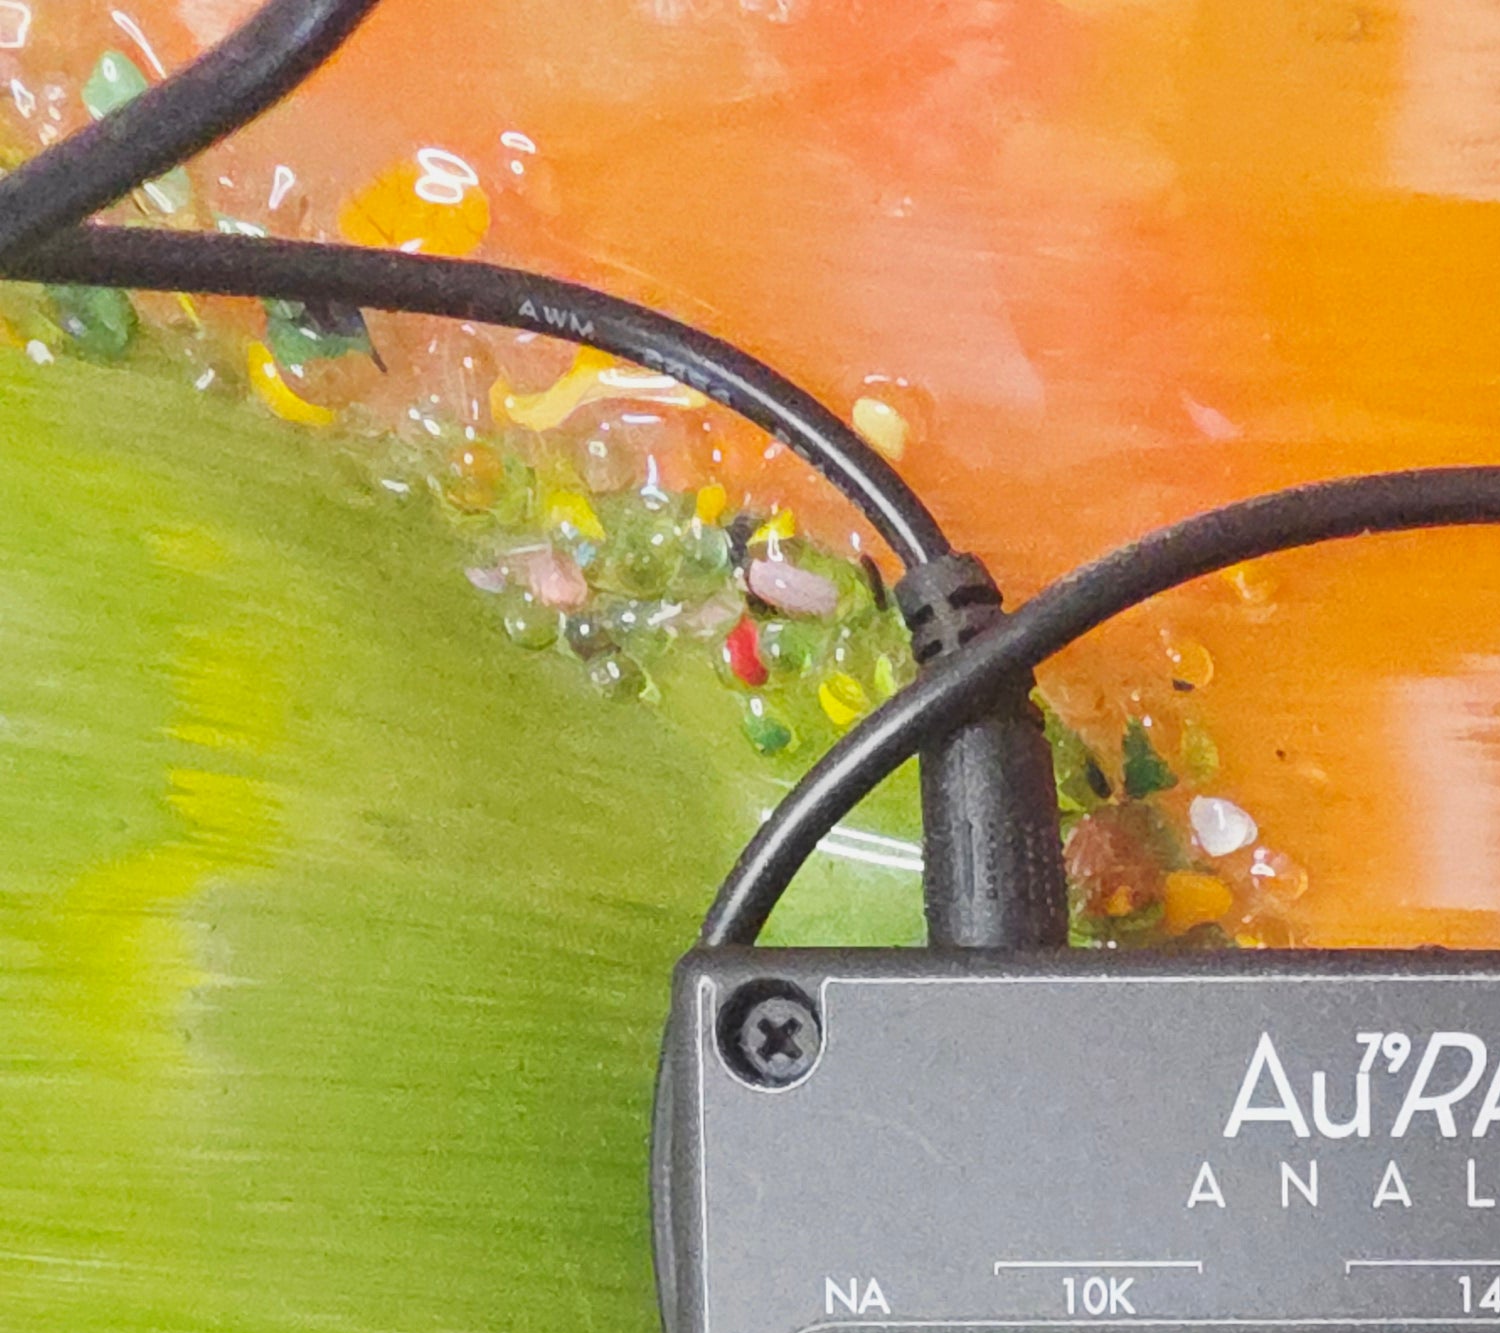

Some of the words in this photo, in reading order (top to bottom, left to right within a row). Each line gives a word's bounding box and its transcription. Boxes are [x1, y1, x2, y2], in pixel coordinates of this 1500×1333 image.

[517, 299, 594, 339] AWM
[825, 1277, 891, 1314] NA
[1062, 1276, 1136, 1315] 10K
